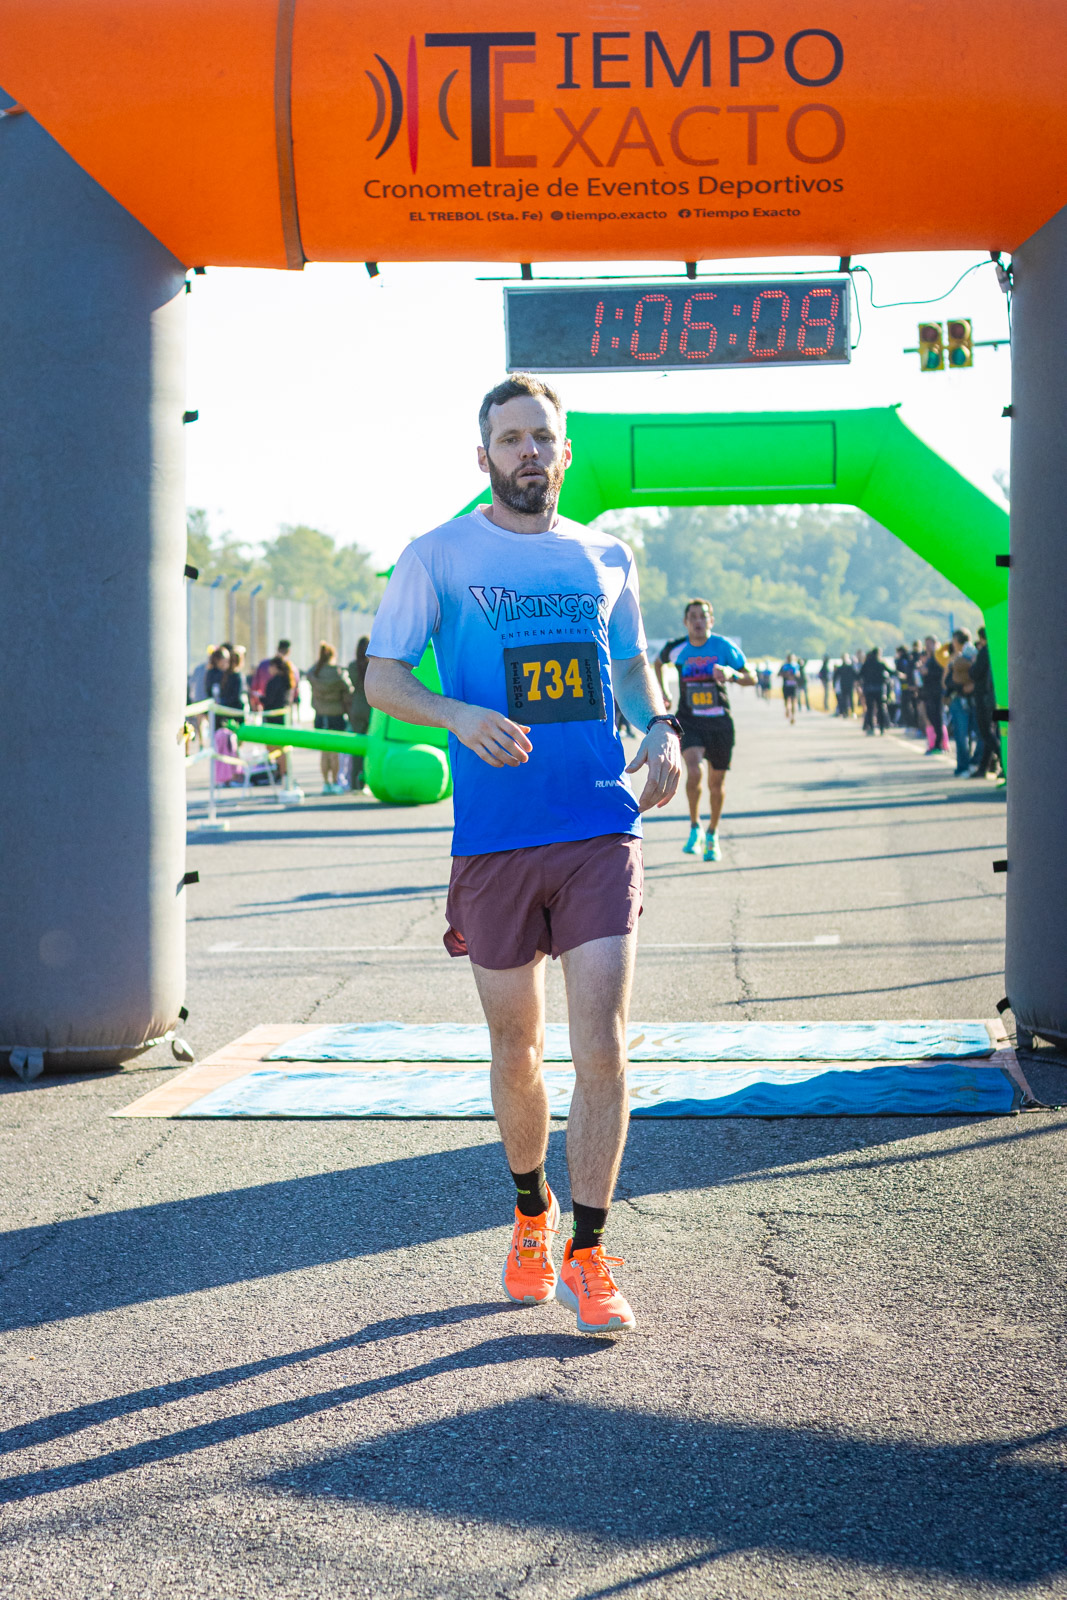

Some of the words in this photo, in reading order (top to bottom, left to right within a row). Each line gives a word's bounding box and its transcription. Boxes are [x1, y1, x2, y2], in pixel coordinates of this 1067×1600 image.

[364, 179, 540, 202] Cronometraje
[546, 177, 579, 197] de
[587, 177, 690, 197] Eventos
[698, 175, 844, 198] Deportivos
[409, 212, 426, 221] EL
[428, 211, 484, 221] TREBOL
[487, 211, 519, 222] (Sta.
[522, 211, 543, 222] Fe)
[566, 210, 668, 221] tiempo.exacto
[694, 208, 749, 219] Tiempo
[752, 207, 801, 217] Exacto
[591, 288, 839, 361] 1:06:08
[511, 662, 523, 708] TIEMPO
[522, 658, 584, 701] 734
[584, 658, 596, 706] EXACTO
